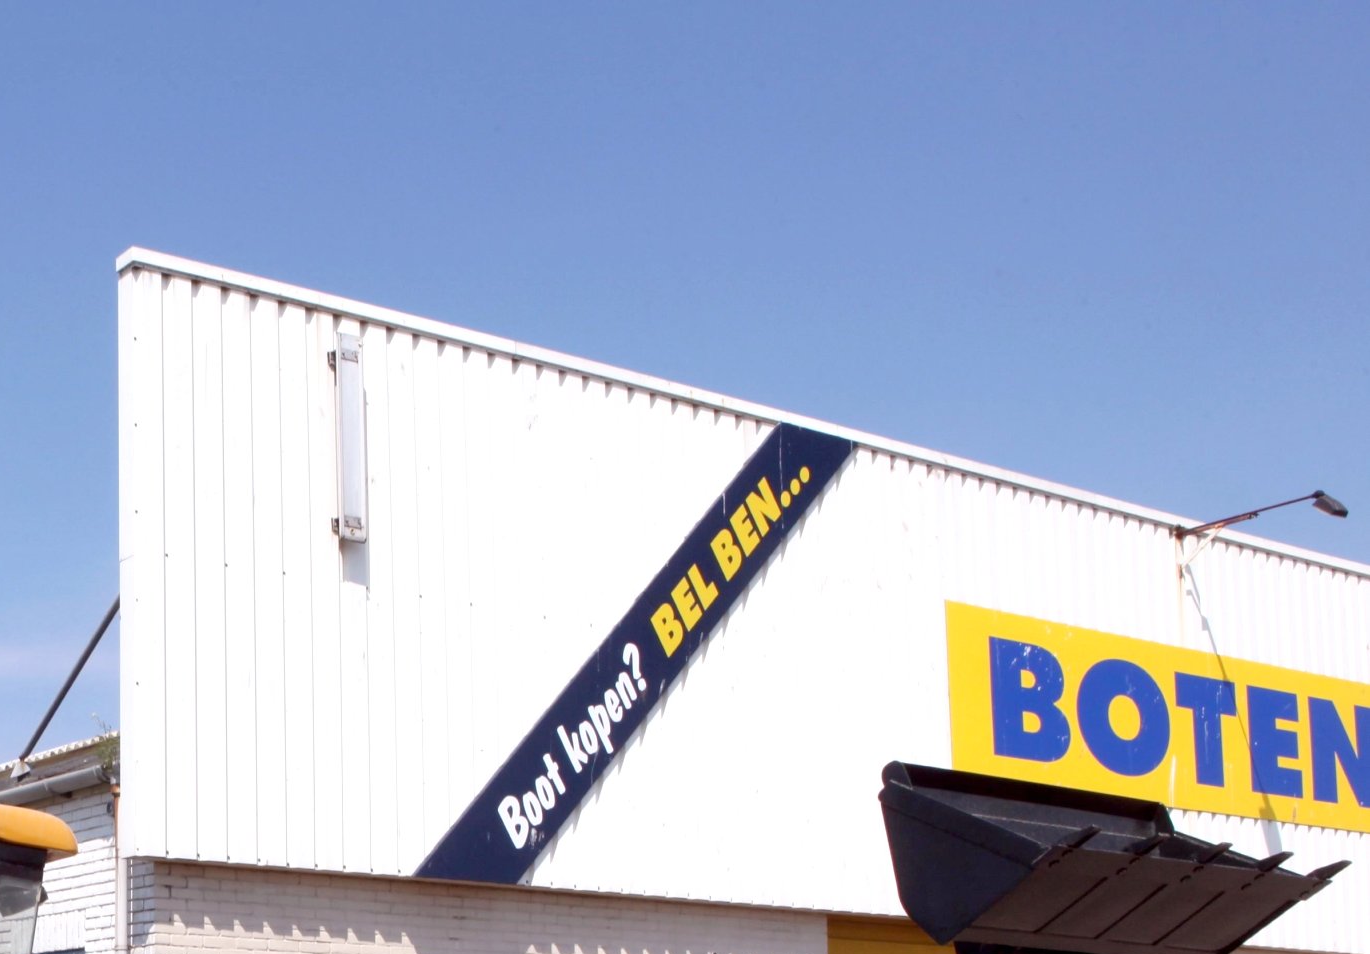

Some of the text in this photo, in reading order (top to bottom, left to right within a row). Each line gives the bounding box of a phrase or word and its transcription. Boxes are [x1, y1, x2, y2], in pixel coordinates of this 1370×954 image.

[497, 466, 810, 850] Boot kopen? BEL BEN...
[988, 635, 1370, 808] BOTEN
